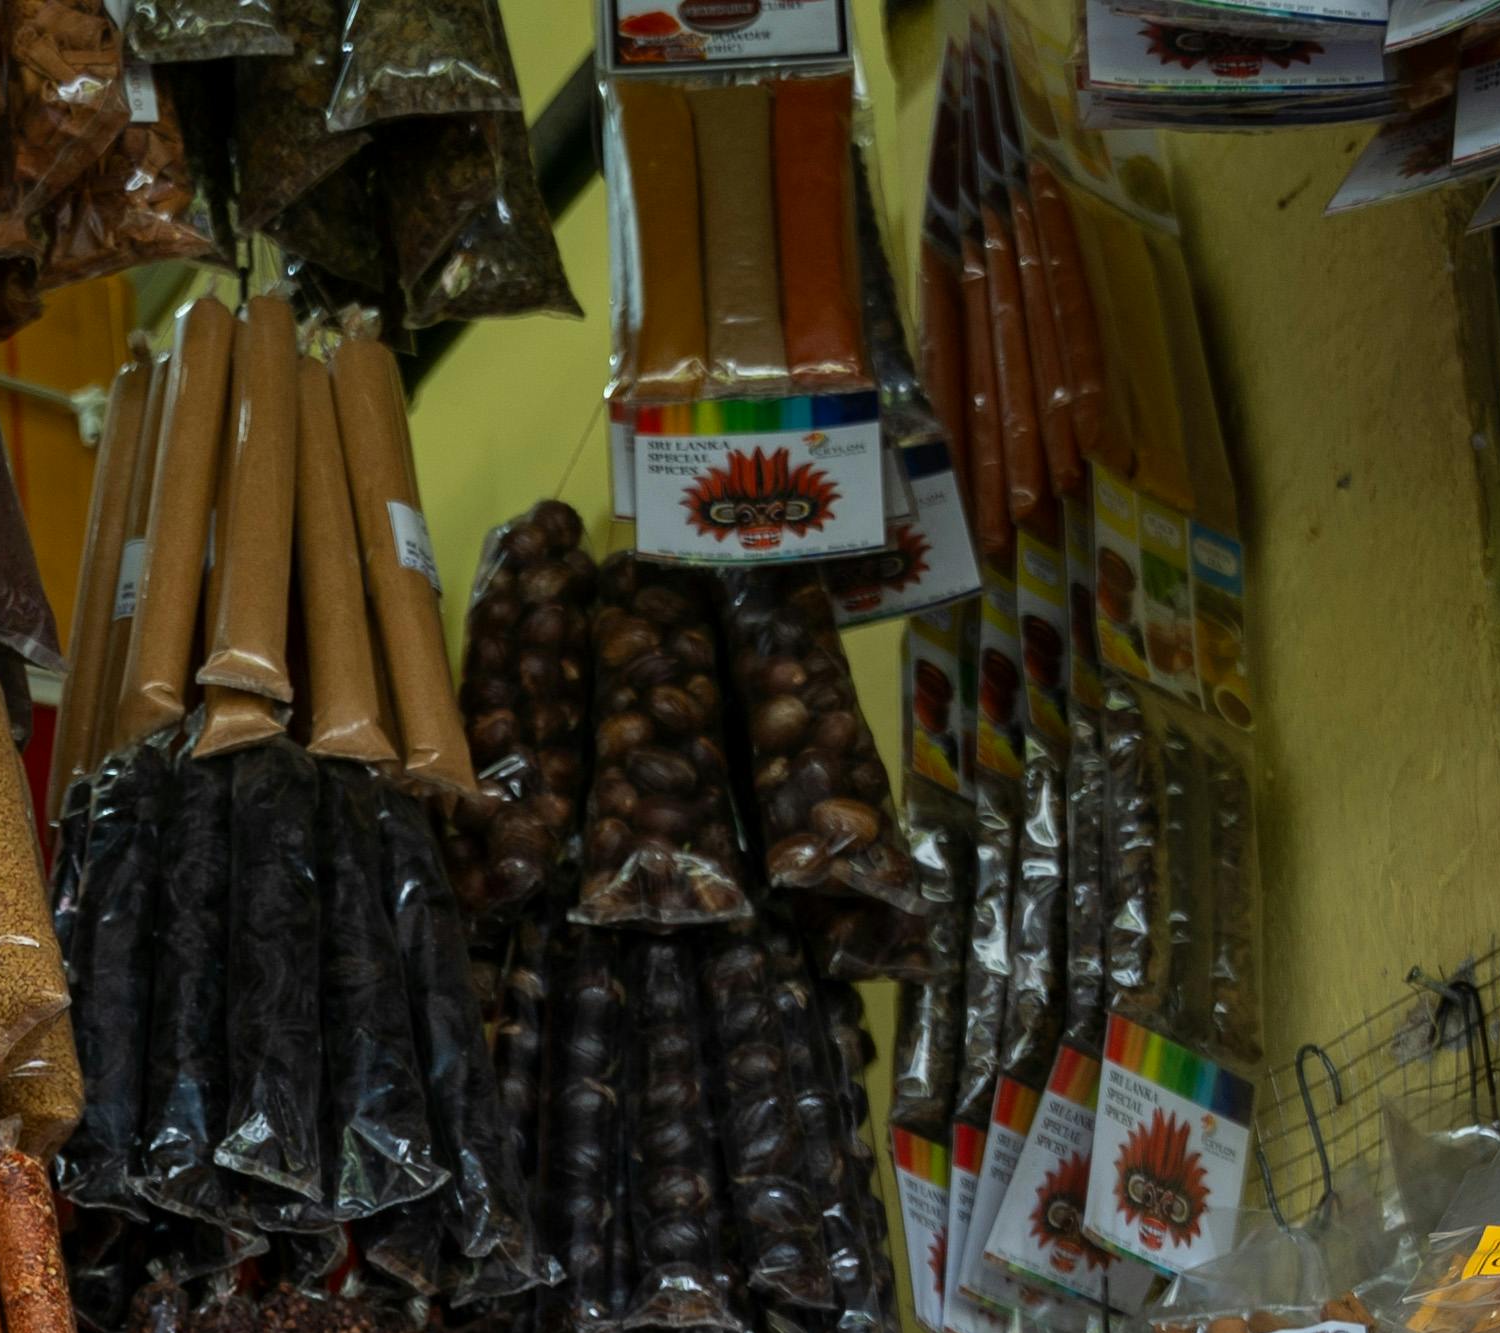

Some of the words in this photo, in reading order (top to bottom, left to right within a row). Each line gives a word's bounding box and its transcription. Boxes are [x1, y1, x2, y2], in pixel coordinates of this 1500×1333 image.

[675, 441, 730, 450] LANKA
[648, 453, 711, 463] SPECIAL
[648, 465, 699, 475] SPICES
[1106, 1087, 1143, 1114] SPECIAL
[1104, 1103, 1133, 1128] SPICES
